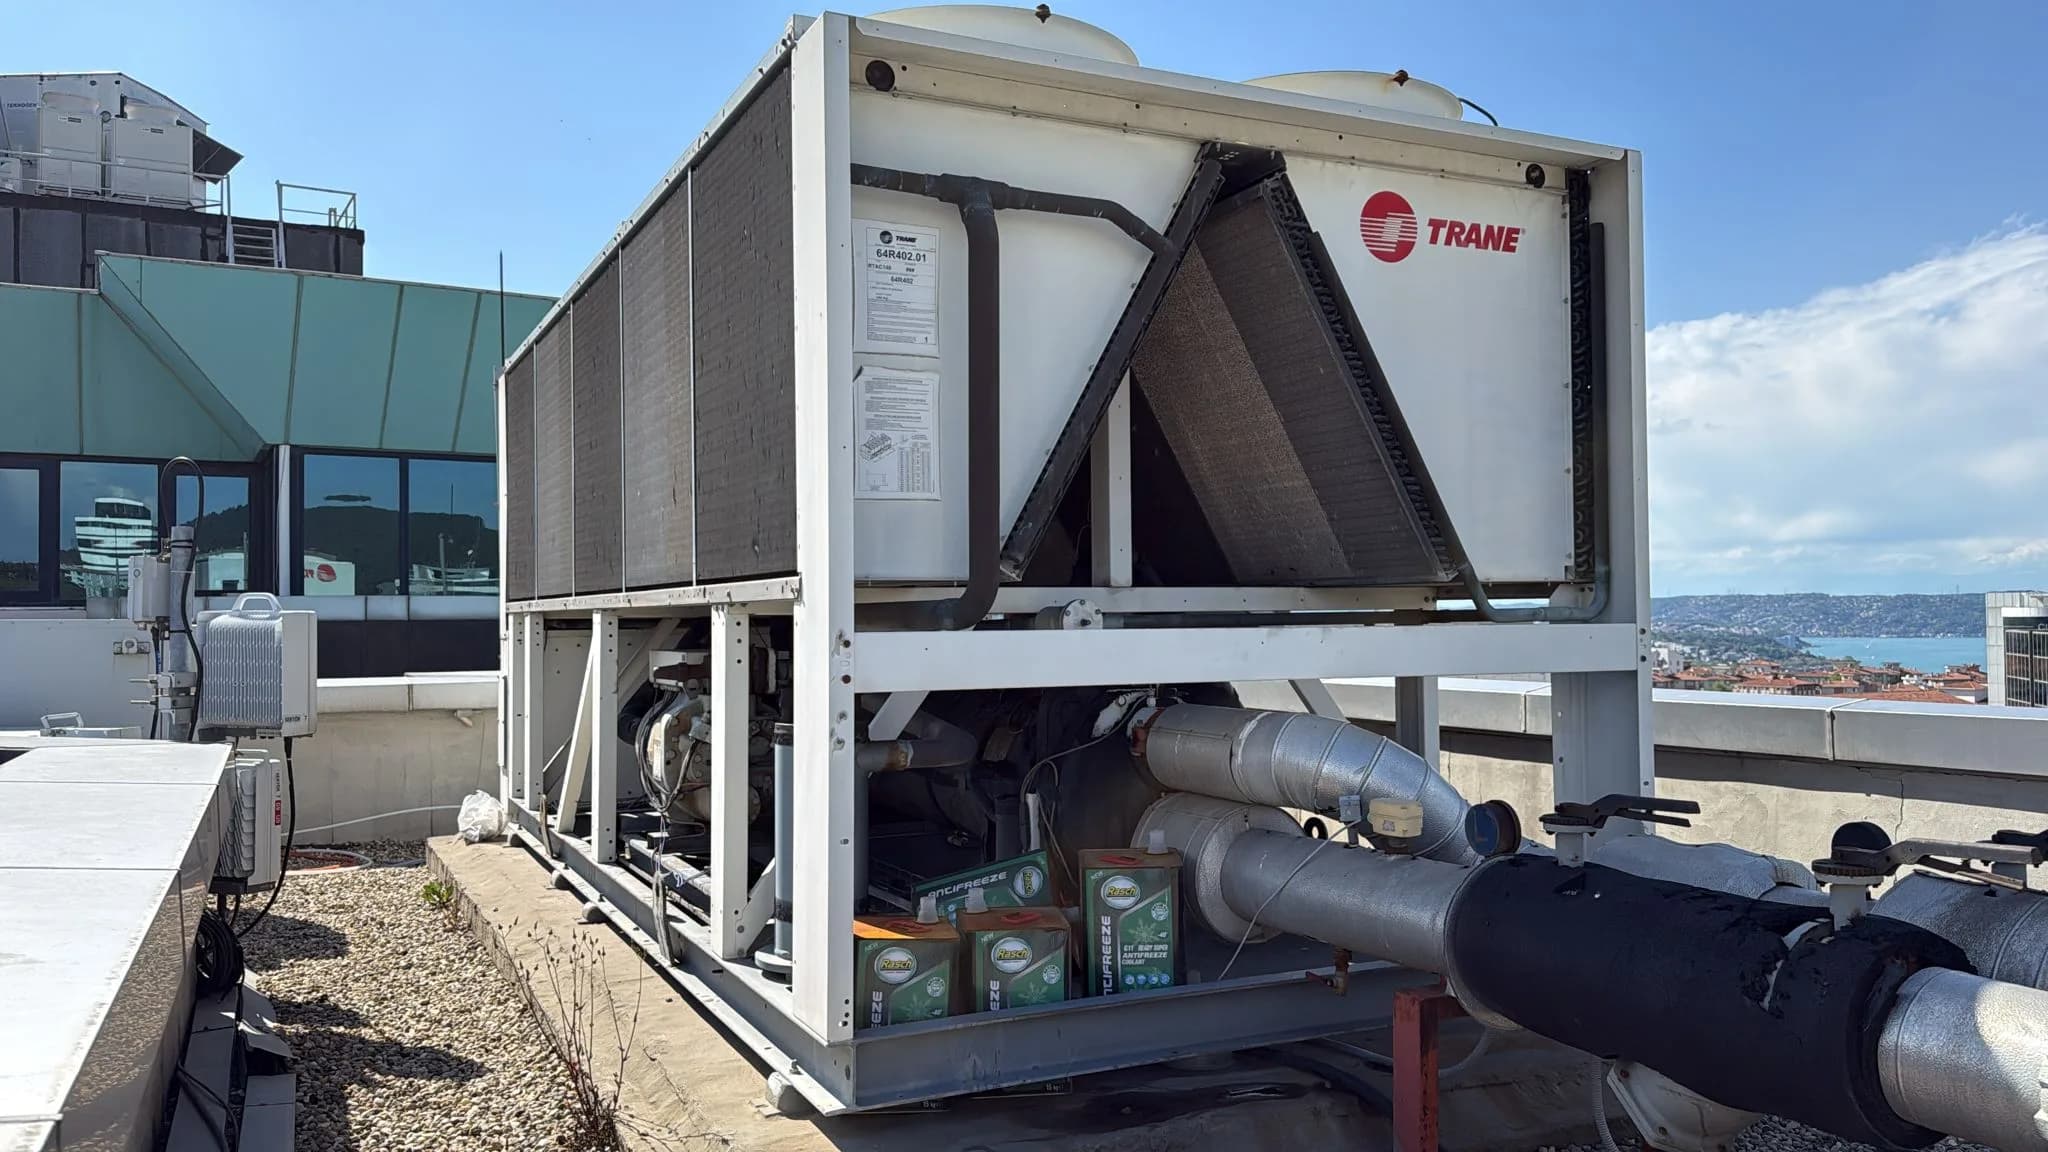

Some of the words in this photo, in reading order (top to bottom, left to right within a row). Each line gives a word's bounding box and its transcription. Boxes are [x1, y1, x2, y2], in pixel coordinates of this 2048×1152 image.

[1427, 218, 1521, 253] TRANE
[876, 248, 926, 262] 64R402.01
[928, 871, 1007, 898] ANTIFREEZE
[1107, 886, 1136, 896] Rasch
[998, 948, 1028, 959] Rasch
[881, 959, 912, 969] Rasch
